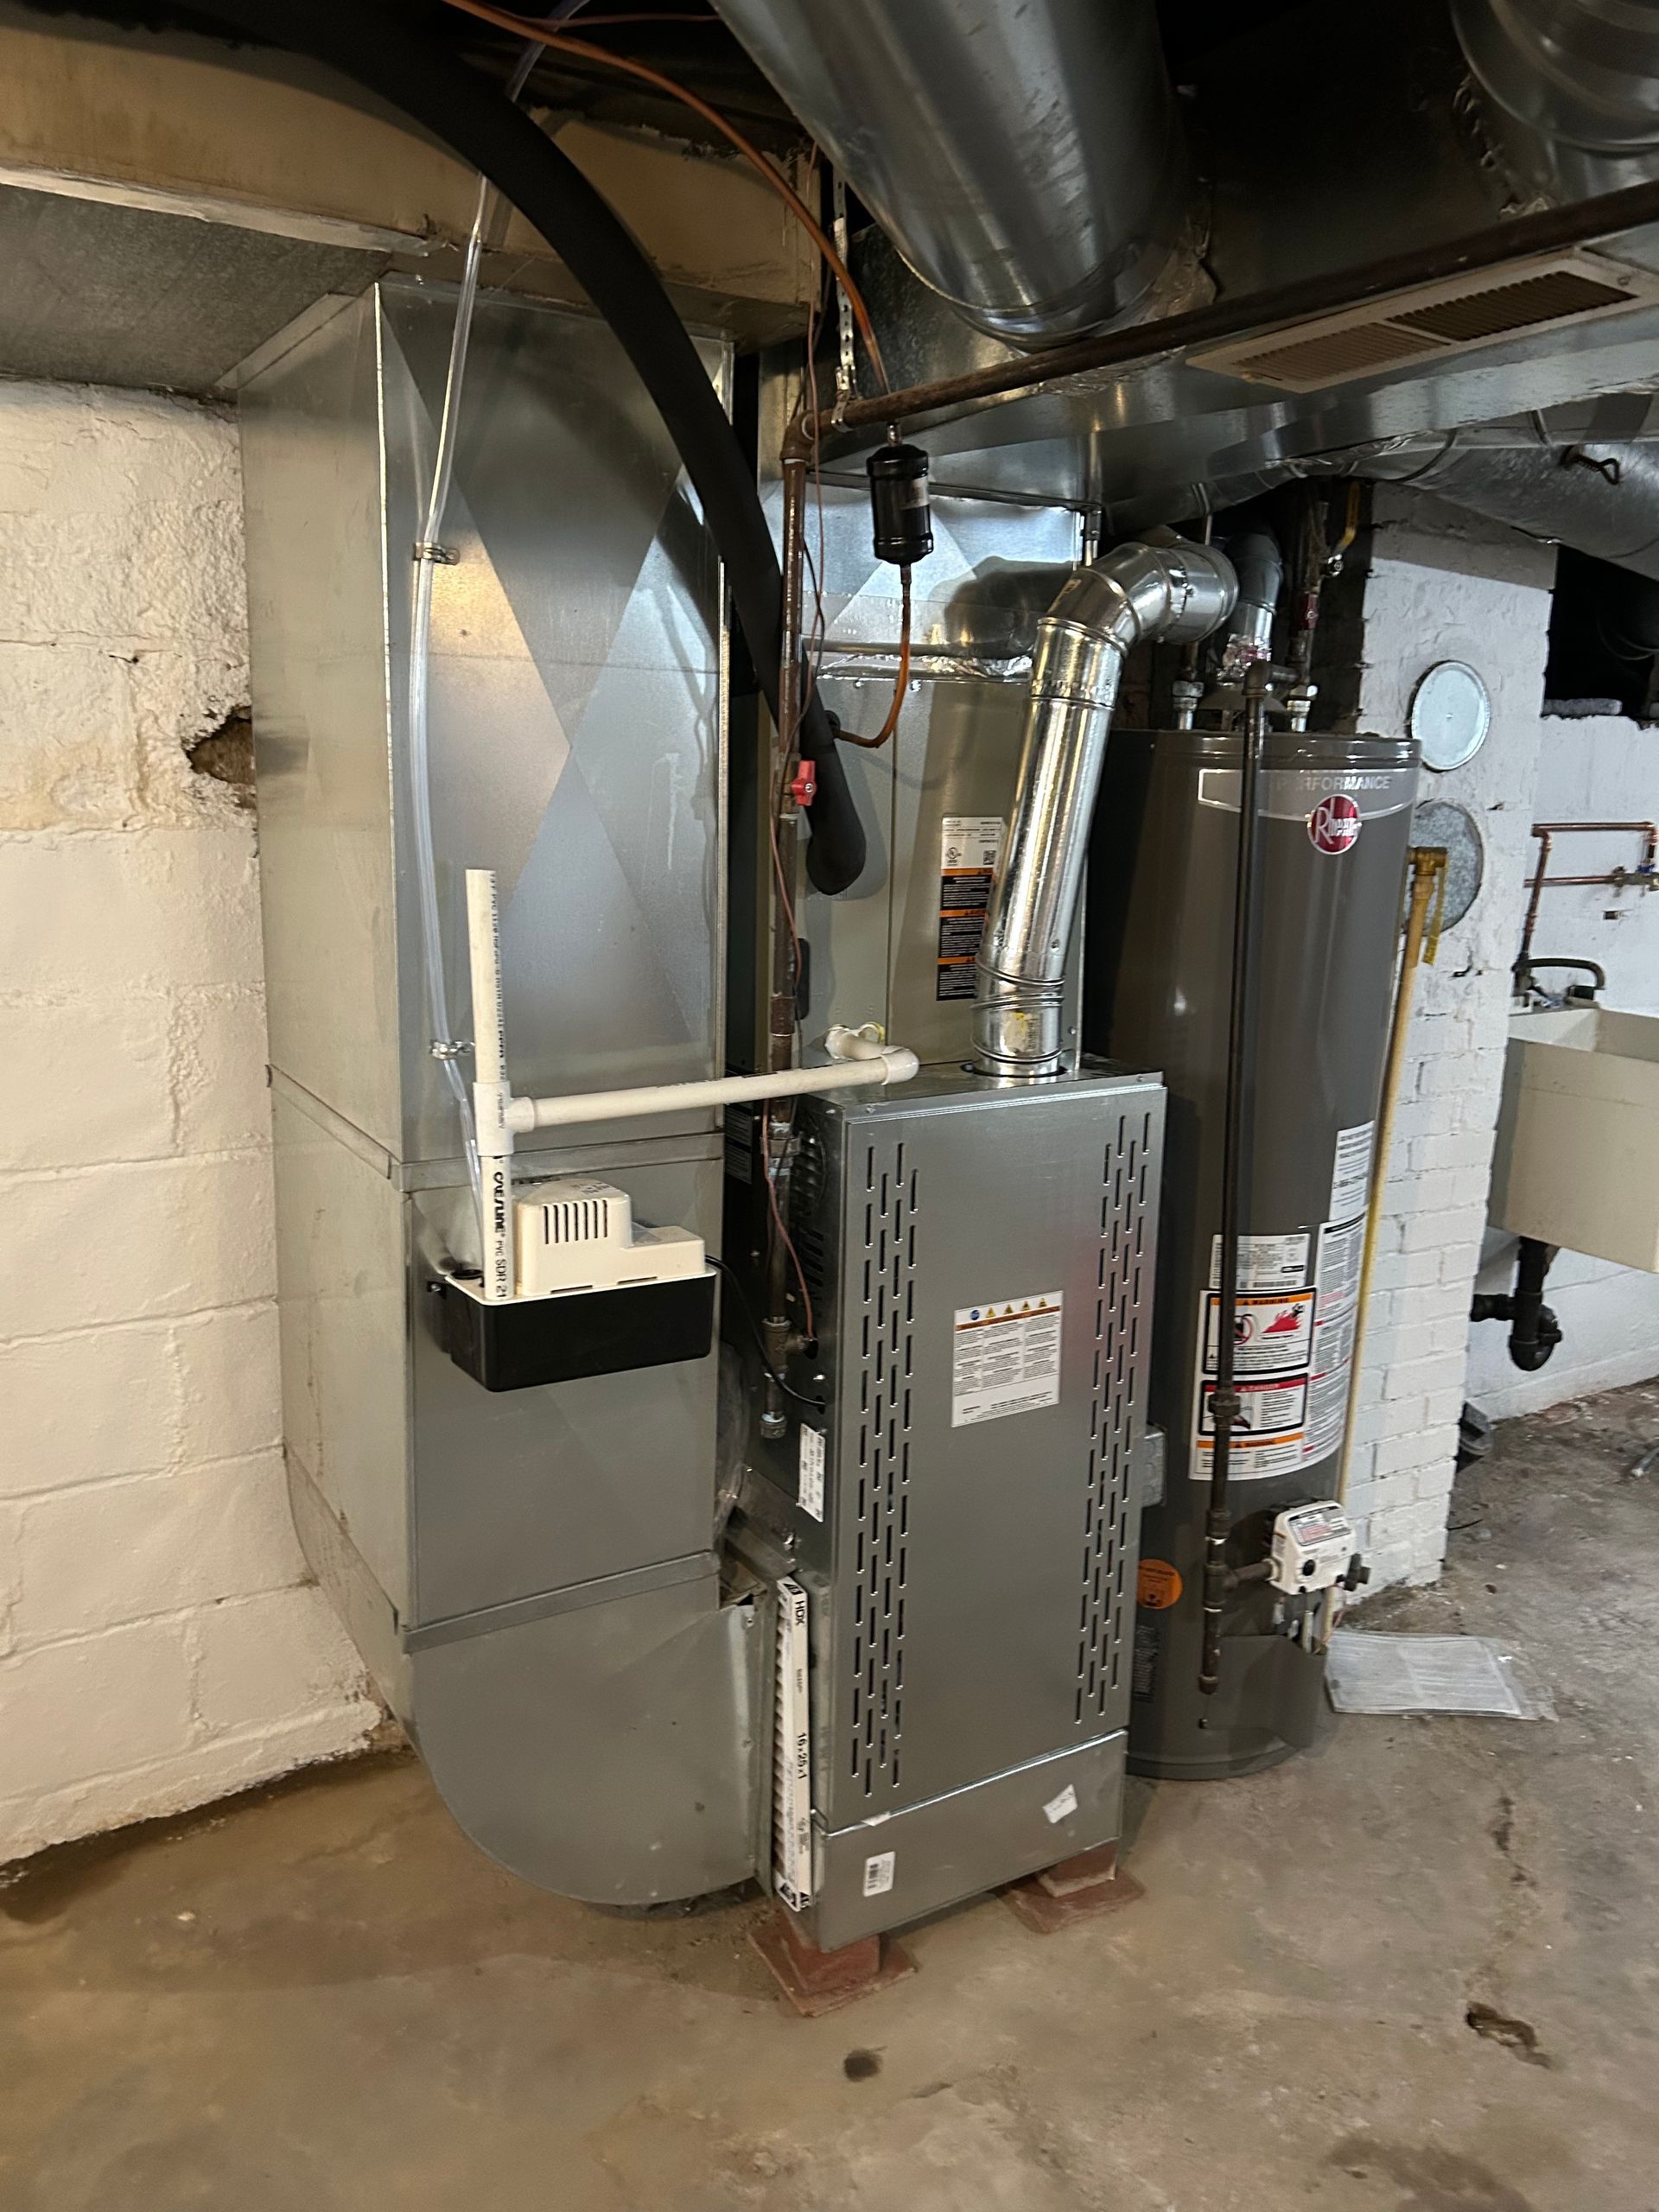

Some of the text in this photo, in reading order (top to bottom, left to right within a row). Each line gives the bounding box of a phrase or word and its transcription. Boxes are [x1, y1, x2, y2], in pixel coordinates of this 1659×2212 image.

[1277, 776, 1391, 791] PRFORMANCE
[495, 1240, 505, 1256] PVC
[495, 1259, 508, 1282] SDR
[495, 1285, 508, 1298] 21
[794, 1600, 805, 1626] HDX
